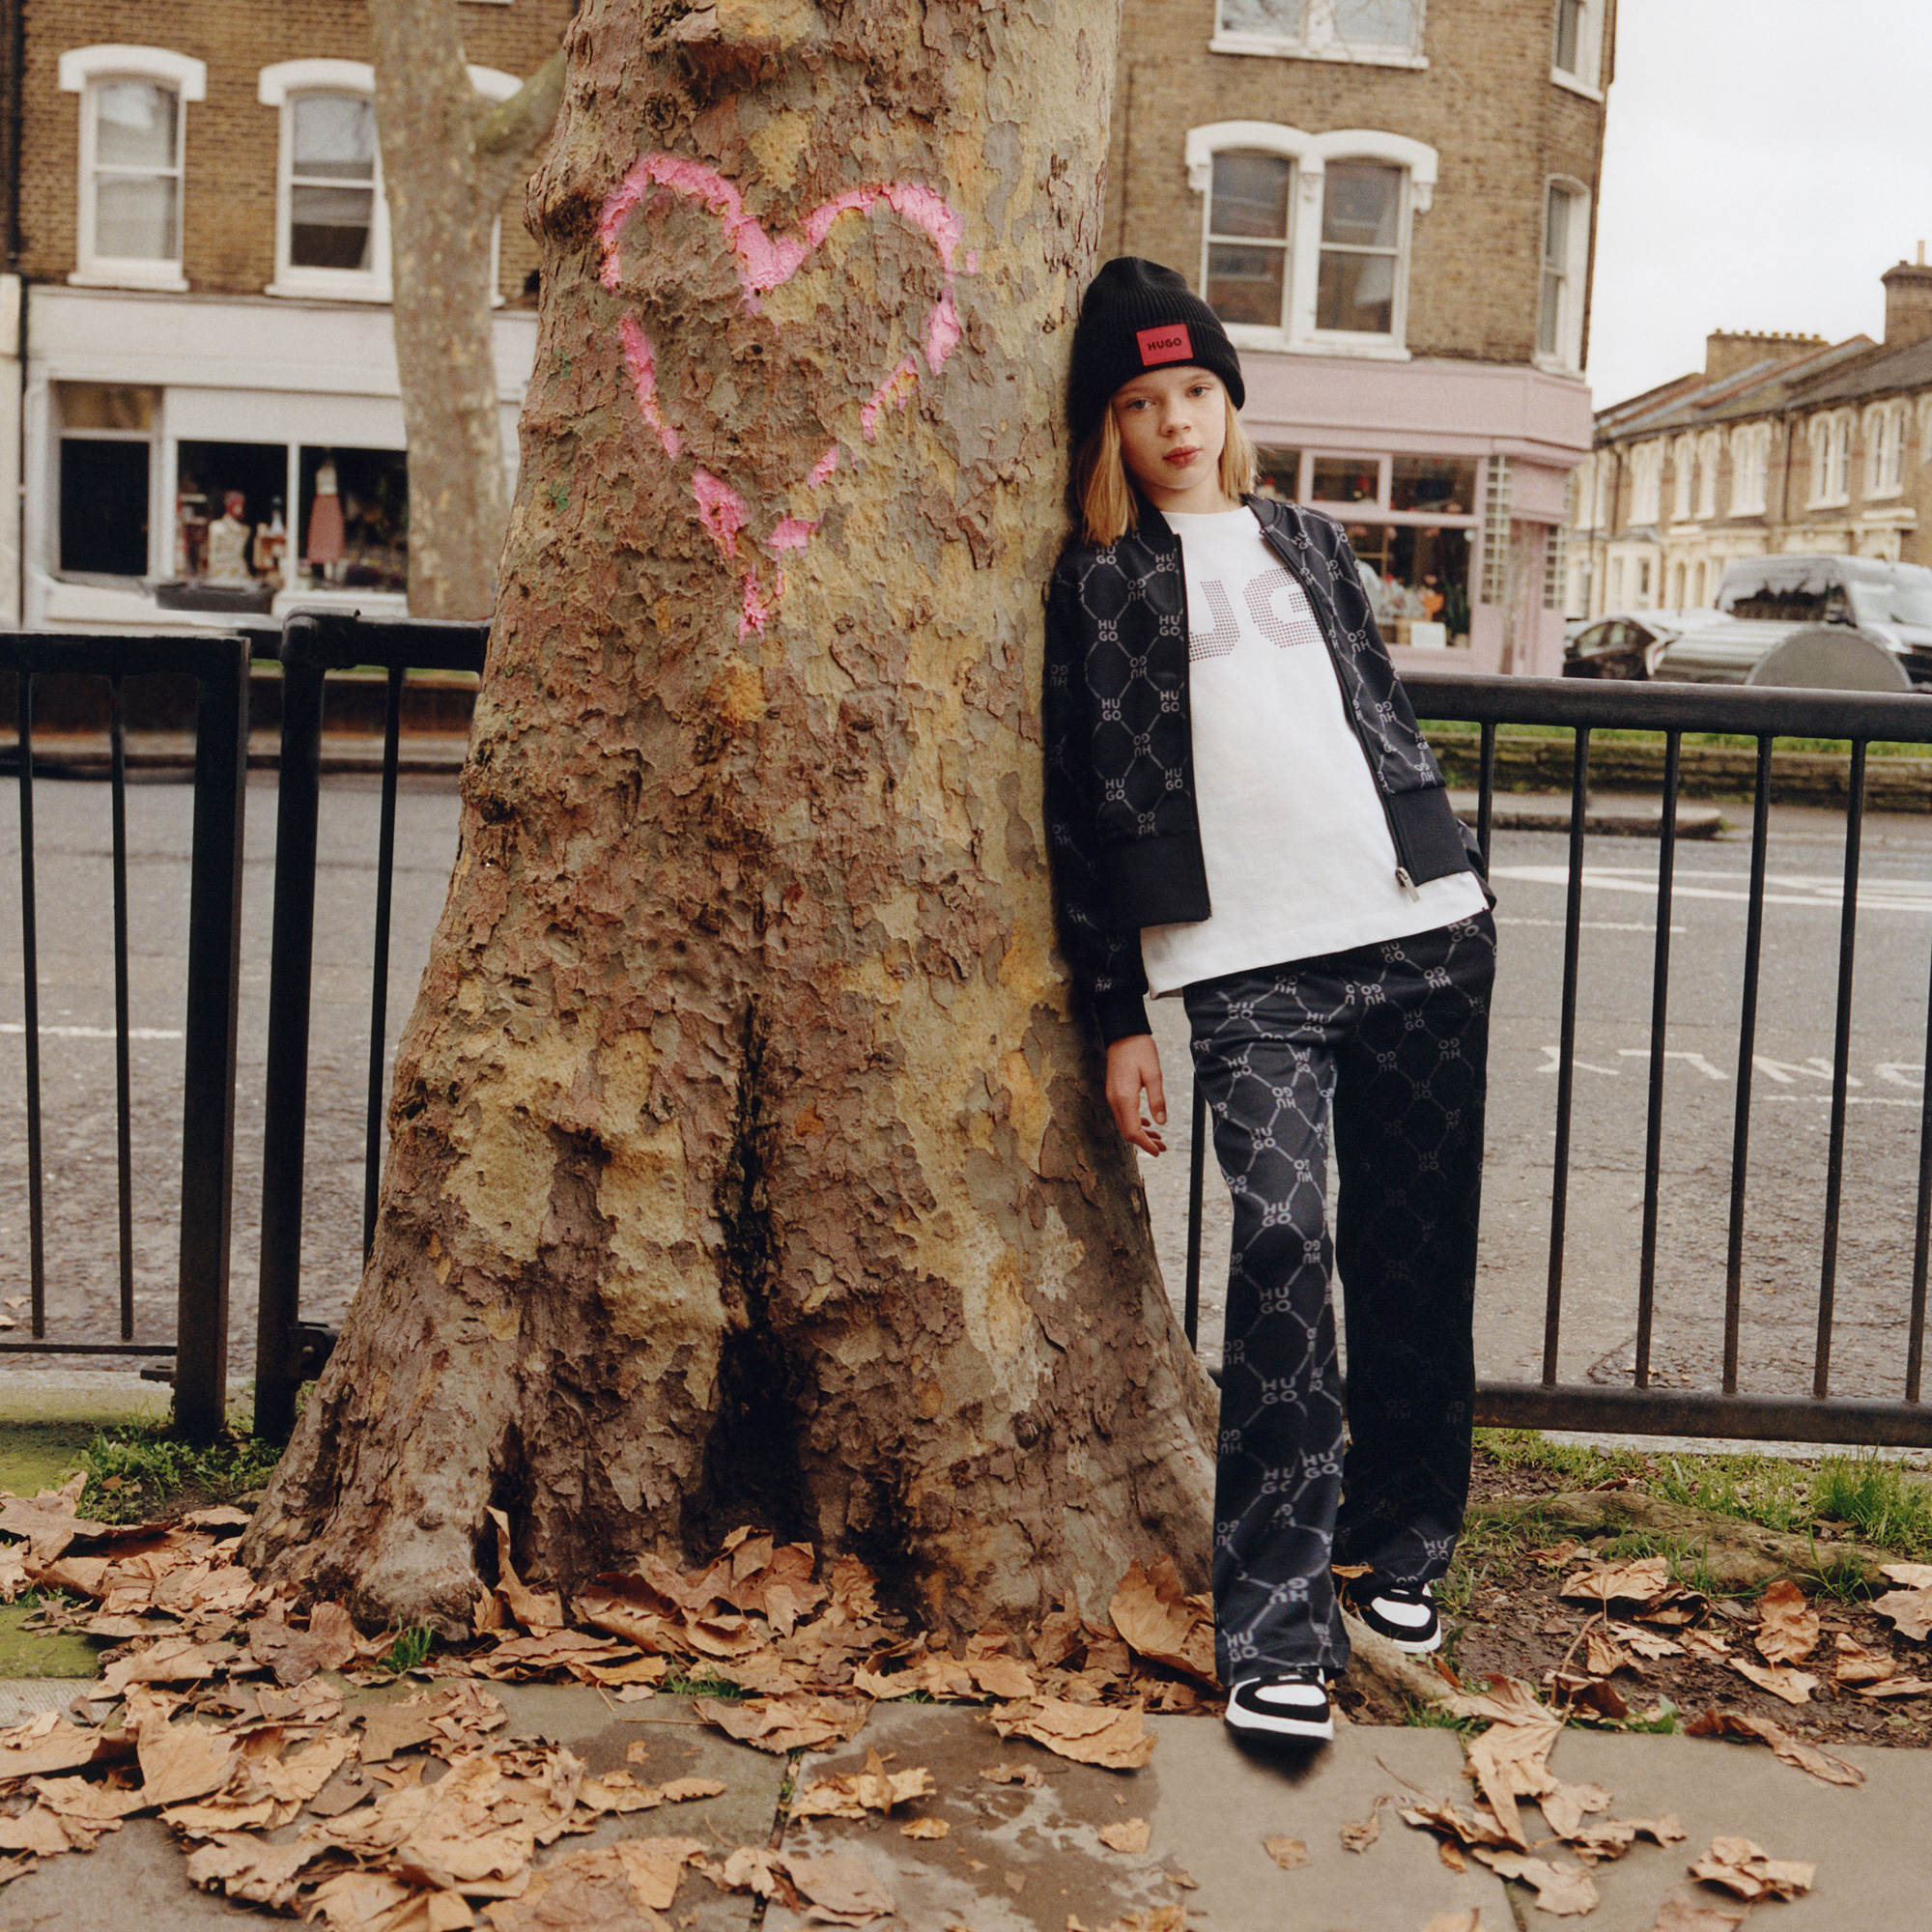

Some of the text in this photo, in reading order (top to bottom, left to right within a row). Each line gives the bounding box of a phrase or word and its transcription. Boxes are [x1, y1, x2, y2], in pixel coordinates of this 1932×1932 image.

[1147, 337, 1182, 352] HUGO
[1095, 554, 1117, 565] GO
[1154, 553, 1176, 563] HU
[1155, 562, 1176, 573] GO
[1126, 578, 1147, 590] GO
[1128, 589, 1146, 602] HU
[1097, 619, 1117, 631] HU
[1159, 614, 1180, 626] HU
[1098, 631, 1119, 642] GO
[1159, 626, 1180, 637] GO
[1348, 629, 1367, 643] GO
[1351, 639, 1371, 653] HU
[1129, 655, 1148, 668] GO
[1130, 667, 1147, 679] HU
[1160, 690, 1179, 701] HU
[1101, 698, 1121, 709] HU
[1160, 701, 1179, 713] GO
[1375, 700, 1393, 712] GO
[1102, 710, 1122, 722] GO
[1378, 711, 1397, 724] HU
[1133, 733, 1150, 746] GO
[1134, 744, 1151, 758] HU
[1165, 768, 1182, 780] HU
[1105, 778, 1124, 789] HU
[1165, 779, 1183, 791] GO
[1105, 789, 1125, 802] GO
[1137, 811, 1155, 824] GO
[1138, 822, 1155, 835] HU
[1451, 924, 1480, 943] GO
[1380, 942, 1401, 954] HU
[1384, 951, 1406, 964] GO
[1424, 966, 1445, 980] GO
[1361, 983, 1382, 995] GO
[1429, 976, 1452, 989] HU
[1365, 992, 1386, 1005] HU
[1272, 1087, 1293, 1098] GO
[1275, 1097, 1296, 1109] HU
[1253, 1138, 1275, 1151] GO
[1264, 1202, 1291, 1216] HU
[1262, 1212, 1293, 1228] GO
[1303, 1239, 1321, 1252] GO
[1302, 1253, 1321, 1264] HU
[1259, 1287, 1291, 1301] HU
[1260, 1299, 1292, 1314] GO
[1261, 1376, 1295, 1392] HU
[1262, 1390, 1298, 1406] GO
[1220, 1430, 1241, 1442] GO
[1220, 1442, 1242, 1455] HU
[1302, 1451, 1334, 1467] HU
[1263, 1466, 1294, 1482] HU
[1304, 1462, 1340, 1480] GO
[1424, 1540, 1447, 1549] HU
[1268, 1589, 1309, 1604] HU
